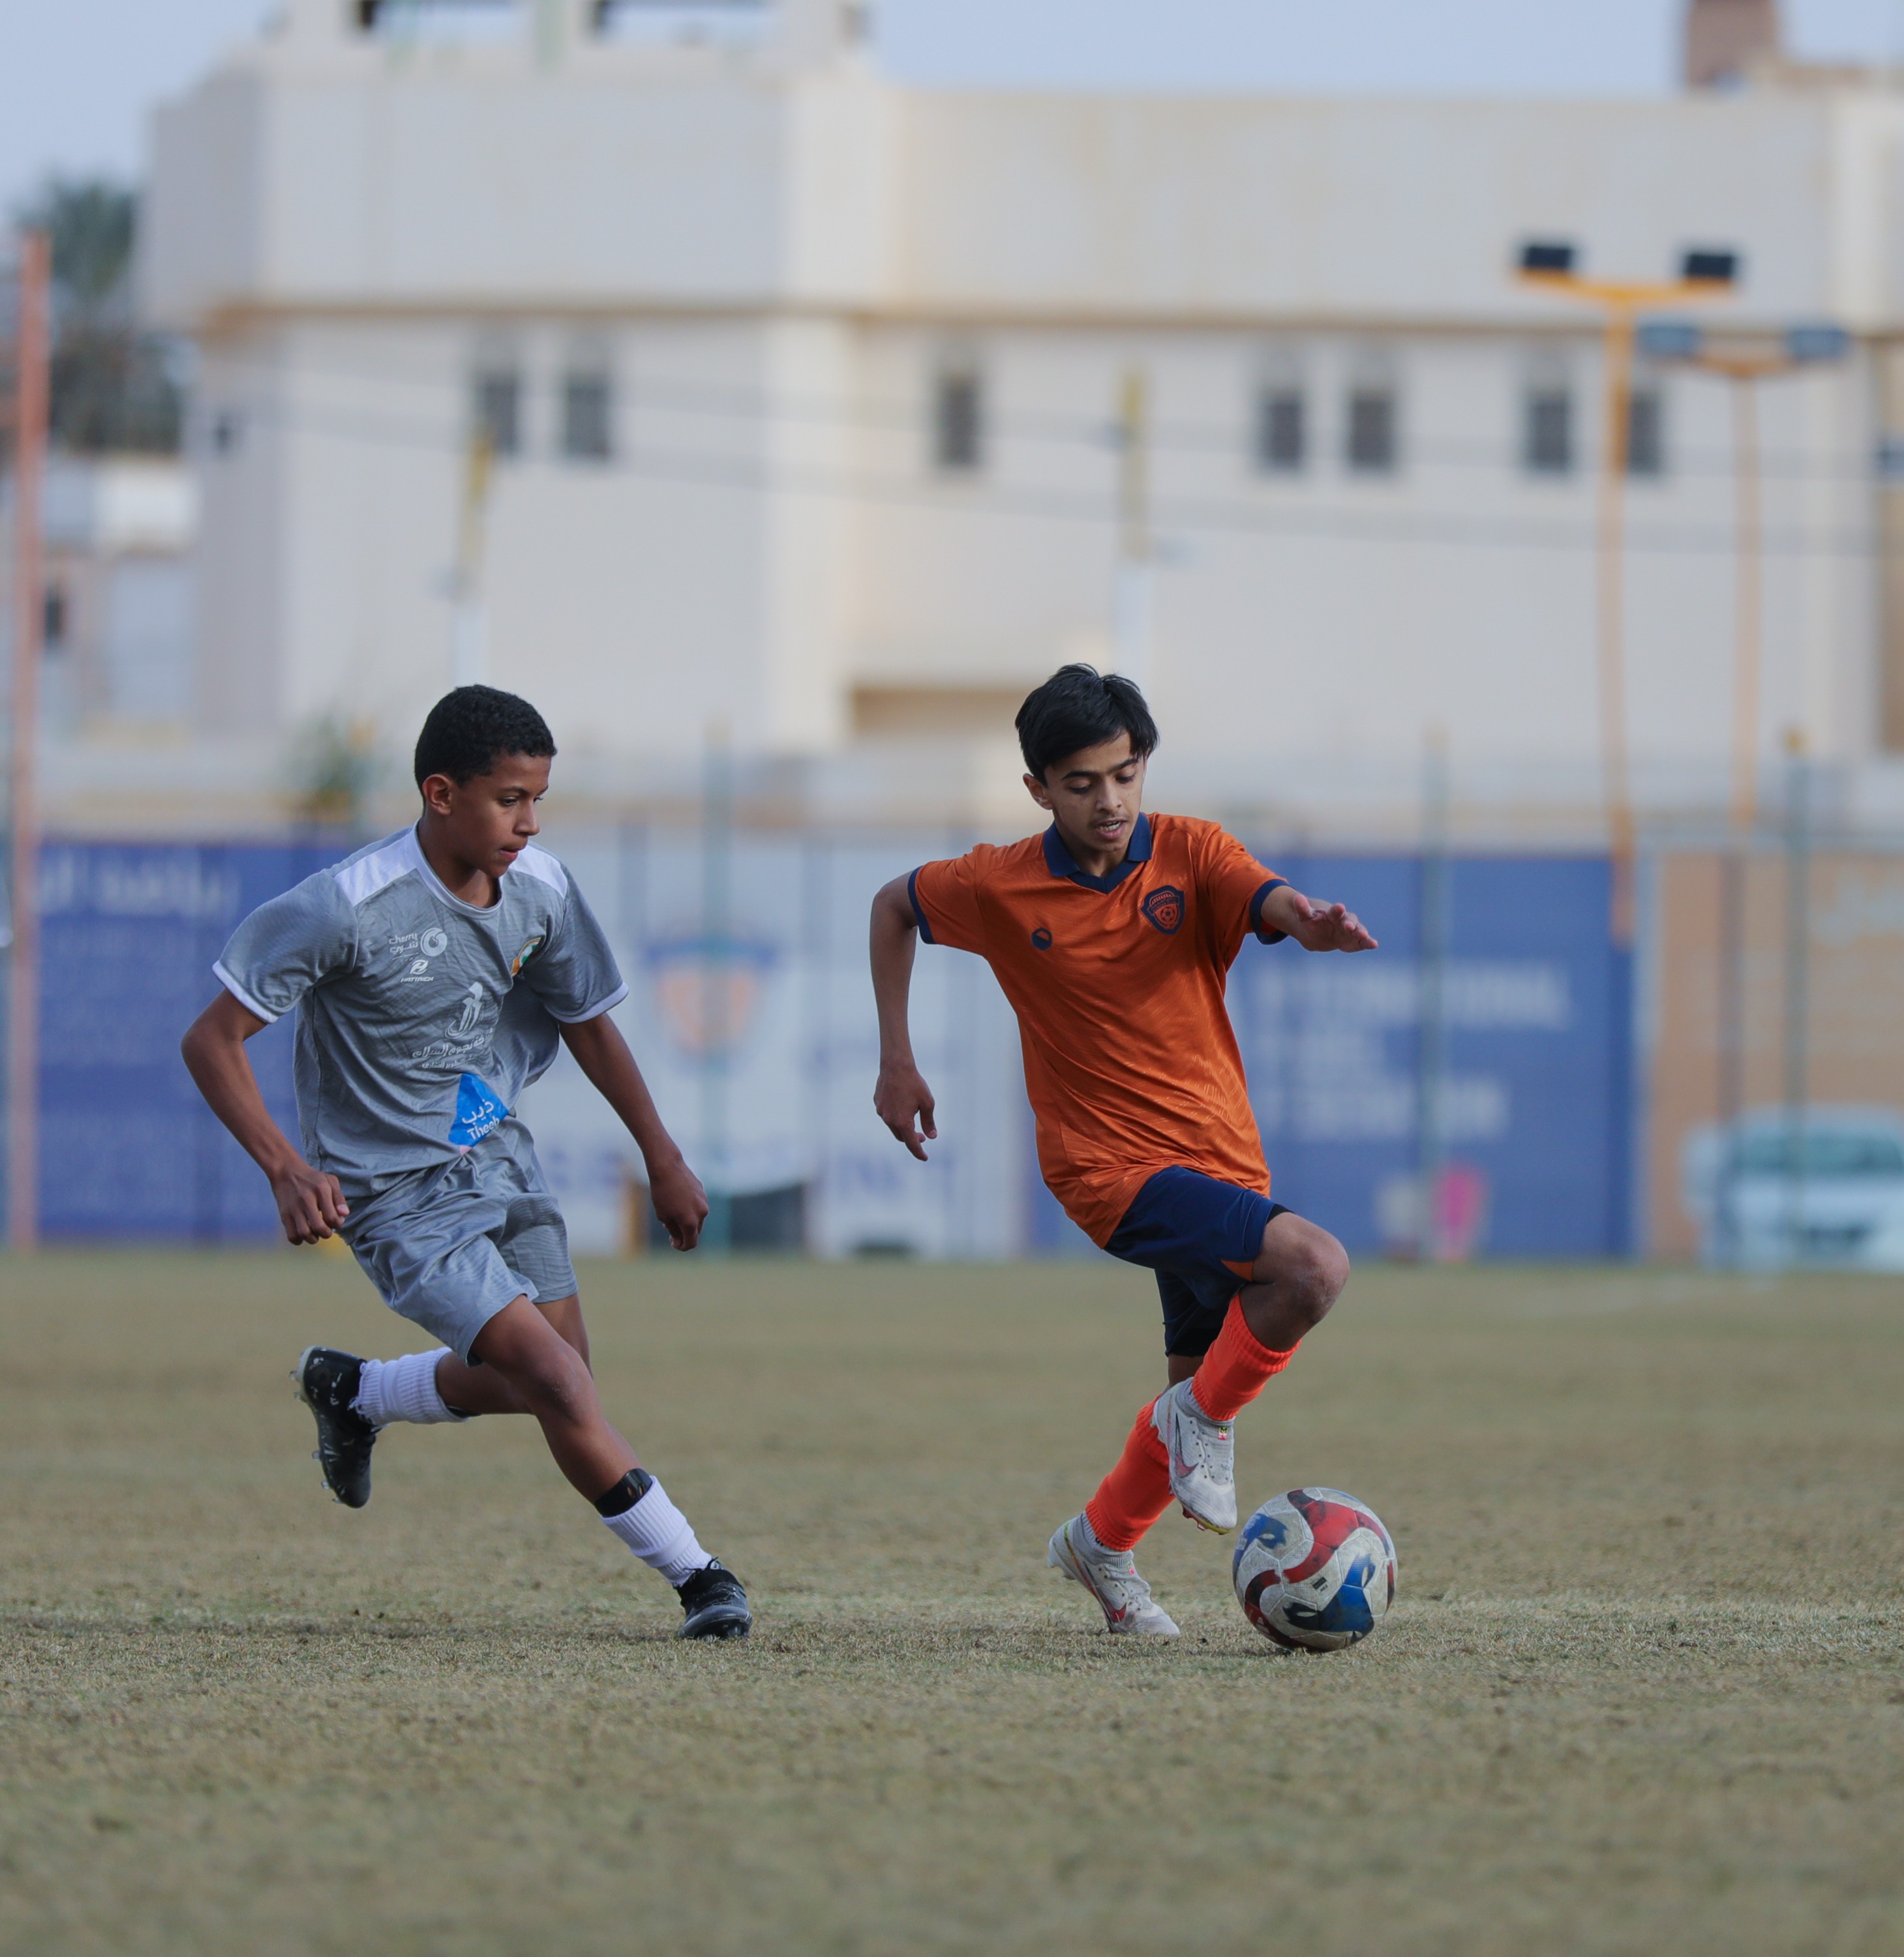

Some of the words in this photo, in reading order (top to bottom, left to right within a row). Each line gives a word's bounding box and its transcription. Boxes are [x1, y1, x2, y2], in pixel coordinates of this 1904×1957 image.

[389, 933, 417, 945] cherry
[412, 1043, 449, 1058] السلام
[462, 1099, 494, 1126] ذيب
[466, 1115, 500, 1140] Theeb
